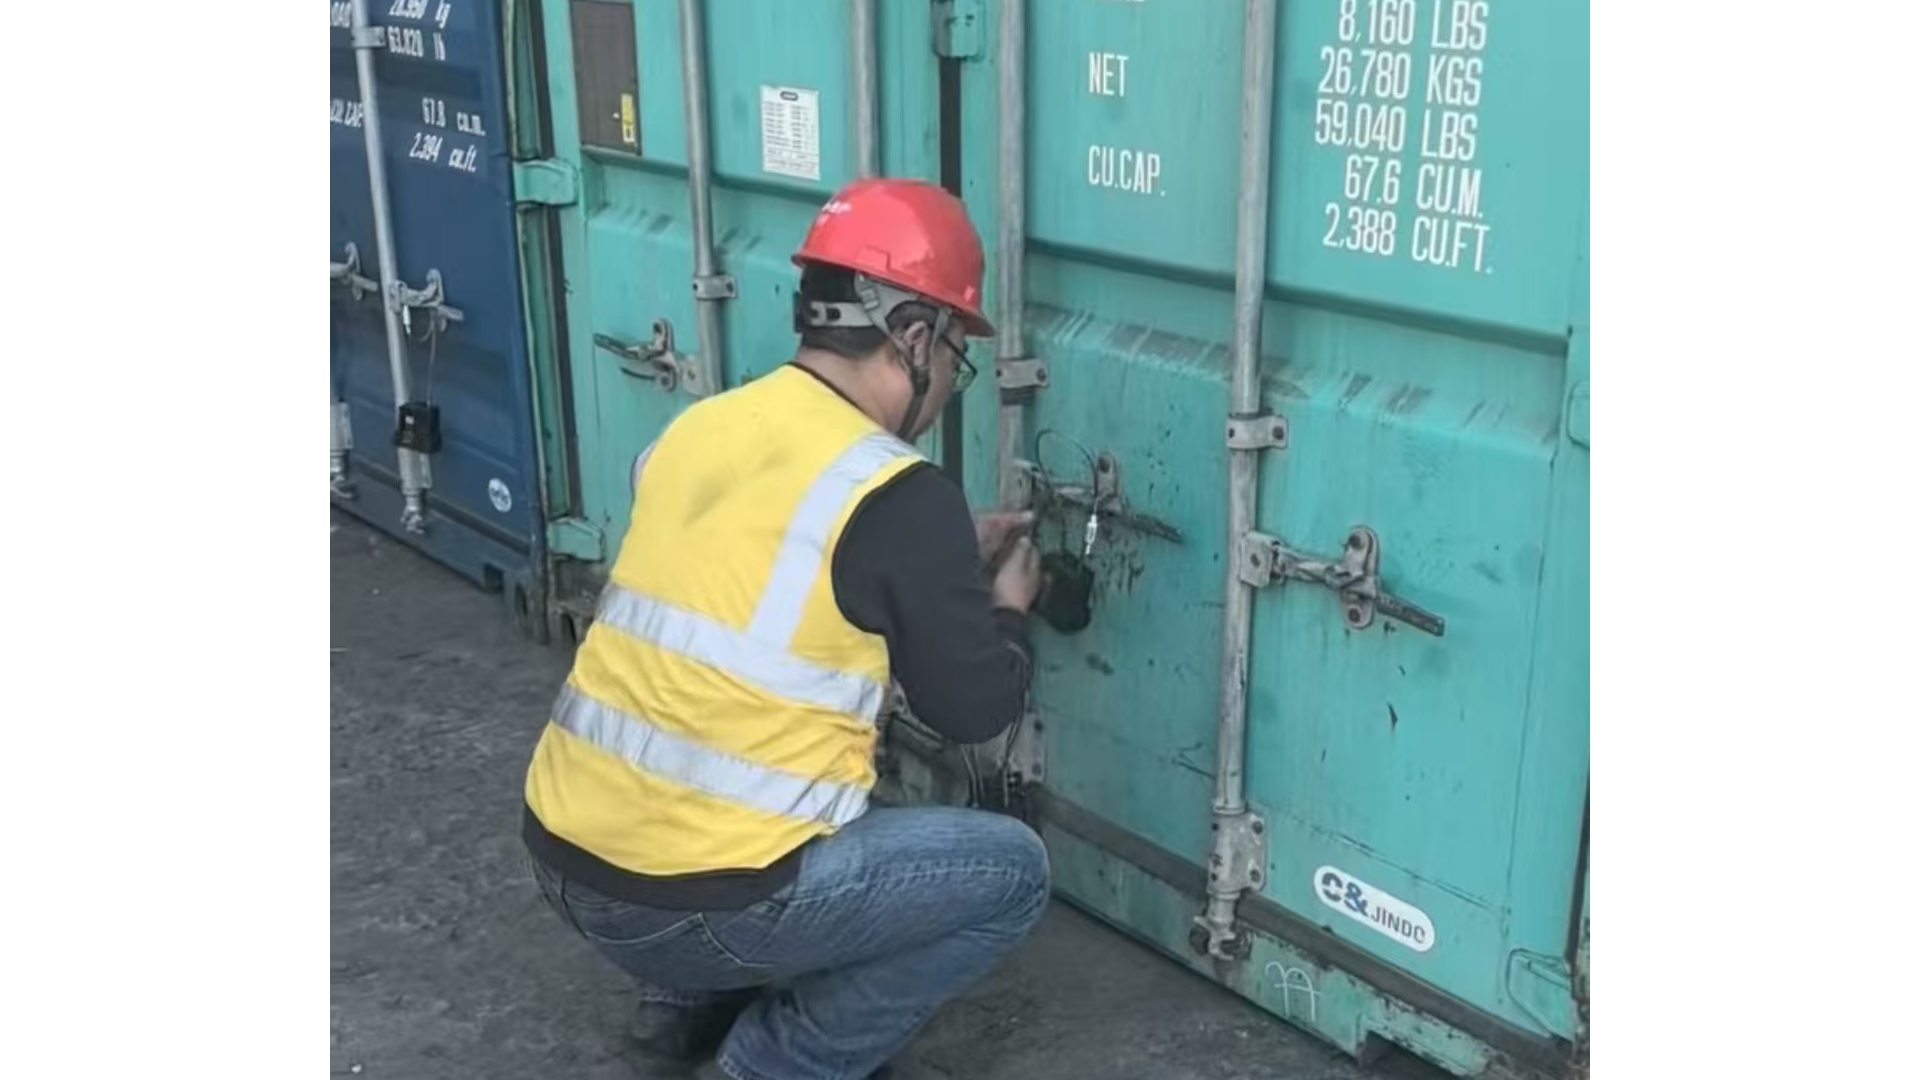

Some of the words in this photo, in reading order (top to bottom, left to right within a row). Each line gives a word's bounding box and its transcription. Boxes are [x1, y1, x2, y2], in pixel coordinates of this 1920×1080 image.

[1338, 0, 1415, 46] 8,160
[1430, 0, 1489, 51] LBS
[1088, 52, 1129, 98] NET
[1319, 47, 1411, 99] 26,780
[1425, 54, 1483, 107] KGS
[1315, 99, 1405, 152] 59,040
[1422, 111, 1478, 161] LBS
[1088, 144, 1167, 197] CU.CAP.
[1345, 154, 1401, 205] 67.6
[1415, 162, 1484, 219] CU.M.
[1322, 202, 1397, 257] 2,388
[1411, 217, 1495, 275] CU.FT.
